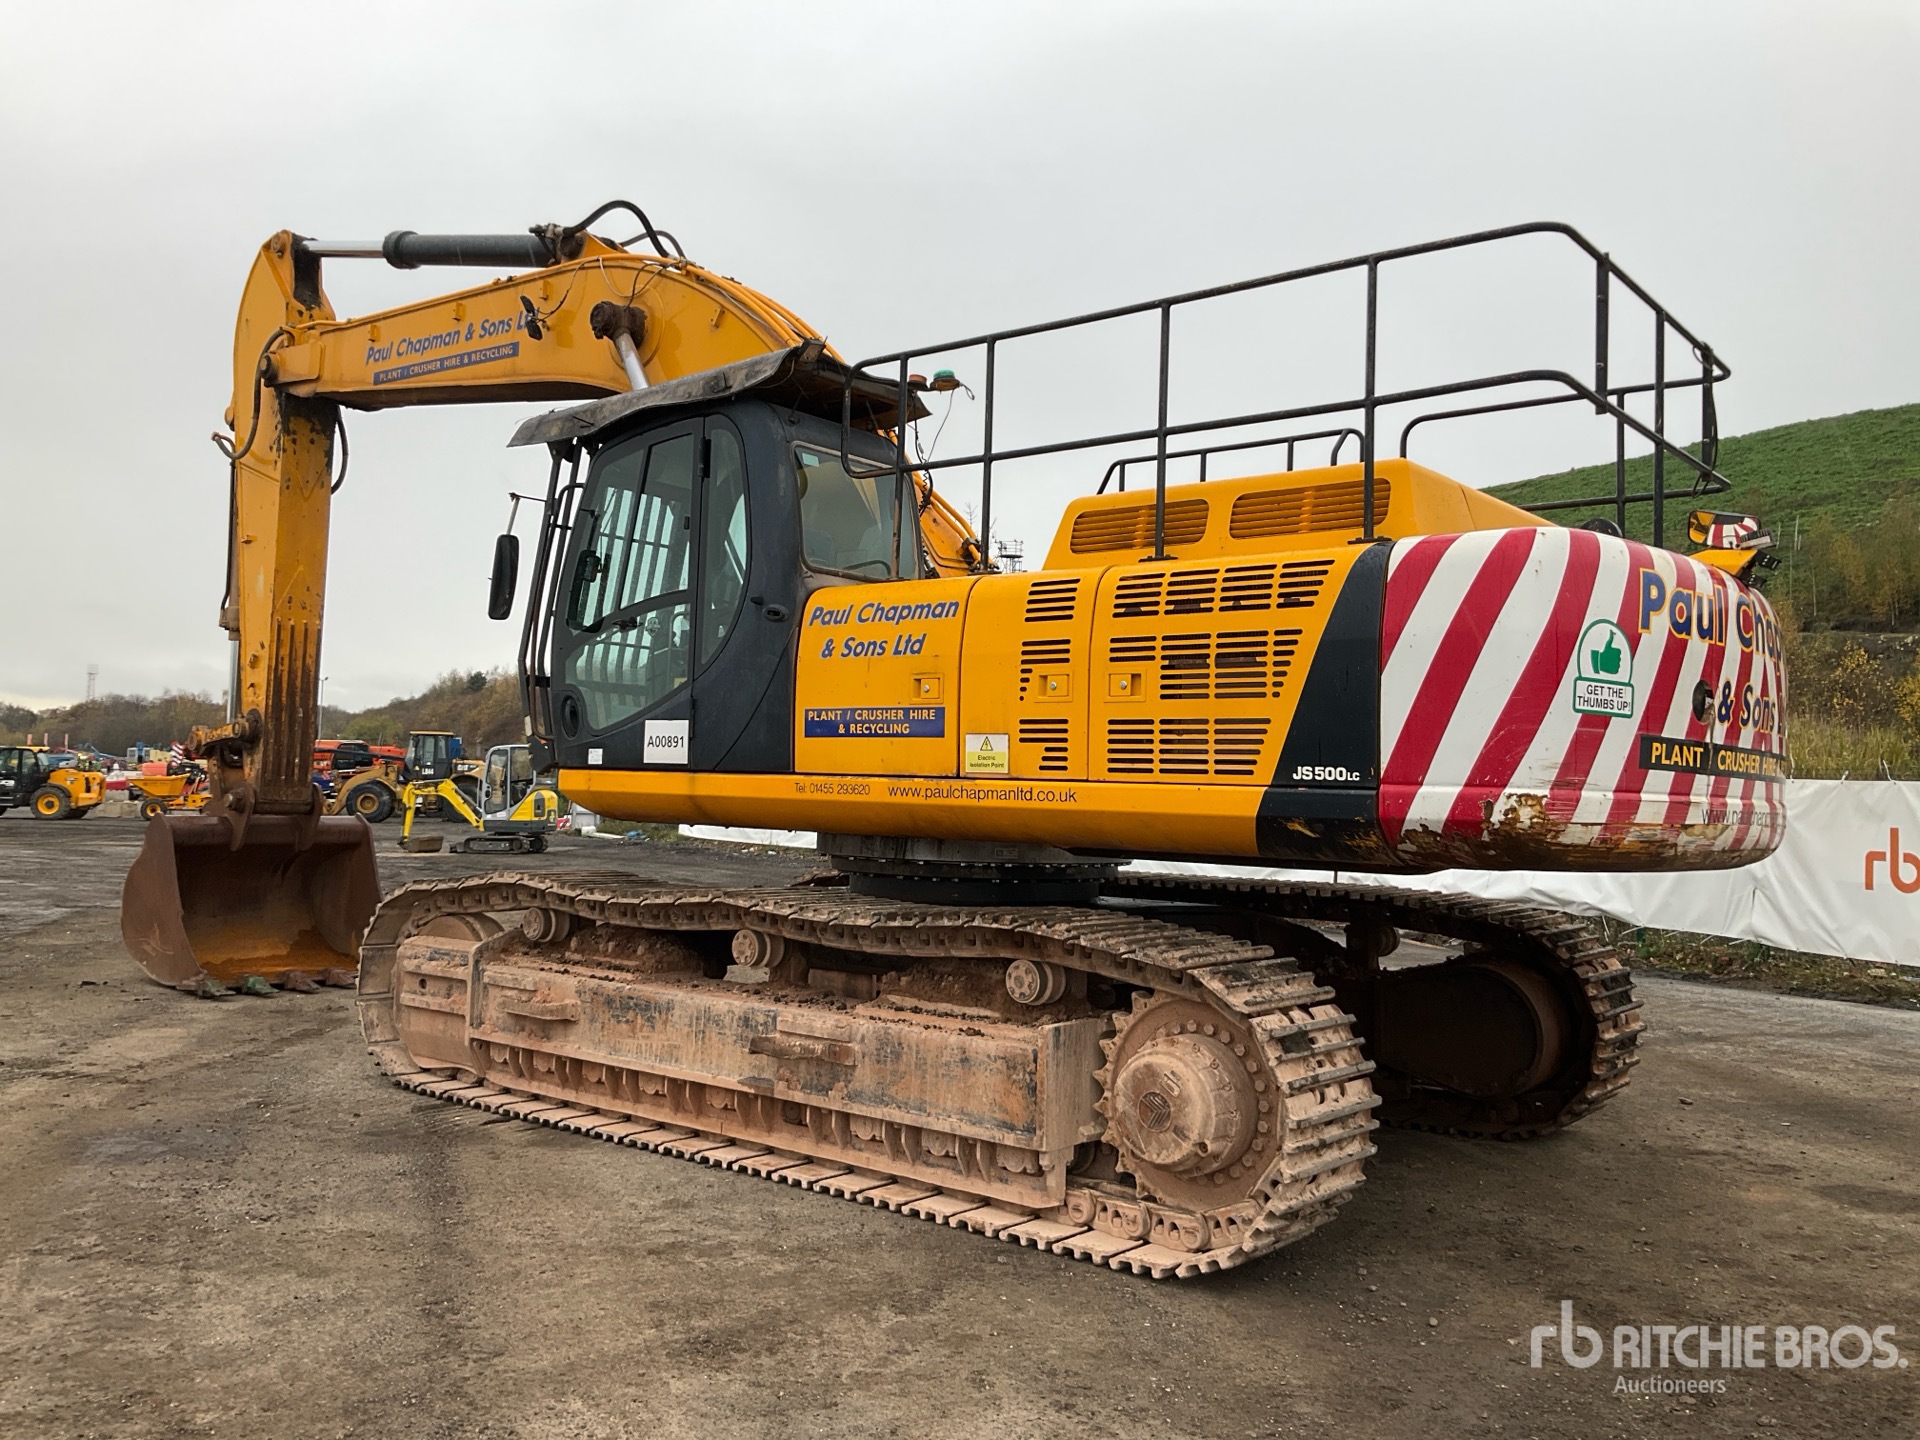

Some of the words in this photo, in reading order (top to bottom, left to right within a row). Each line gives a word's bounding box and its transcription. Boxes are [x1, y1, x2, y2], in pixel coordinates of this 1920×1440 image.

[365, 341, 393, 365] Paul
[396, 329, 460, 356] Chapman
[464, 323, 475, 341] &
[479, 318, 513, 338] Sons
[379, 369, 401, 381] PLANT
[409, 362, 441, 375] CRUSHER
[444, 356, 461, 368] HIRE
[463, 355, 468, 363] &
[471, 345, 514, 362] RECYCLING
[808, 604, 854, 626] Paul
[856, 601, 960, 626] Chapman
[1638, 567, 1725, 647] Paul
[820, 637, 836, 659] &
[840, 636, 888, 658] Sons
[892, 632, 928, 656] Ltd
[1586, 684, 1605, 696] GET
[1607, 686, 1624, 699] THE
[1577, 695, 1615, 710] THUMBS
[1616, 700, 1631, 712] UP!
[1717, 676, 1736, 728] &
[1738, 681, 1776, 734] Sons
[808, 710, 842, 721] PLANT
[846, 710, 851, 720] /
[854, 709, 904, 720] CRUSHER
[909, 709, 936, 720] HIRE
[838, 723, 845, 734] &
[849, 723, 910, 734] RECYCLING
[647, 735, 685, 748] A00891
[1651, 742, 1704, 768] PLANT
[1717, 749, 1760, 775] CRUSHER
[794, 782, 807, 793] Tel:
[809, 782, 834, 794] 01455
[836, 783, 871, 796] 293620
[888, 785, 1078, 803] www.paulchapmanltd.co.uk
